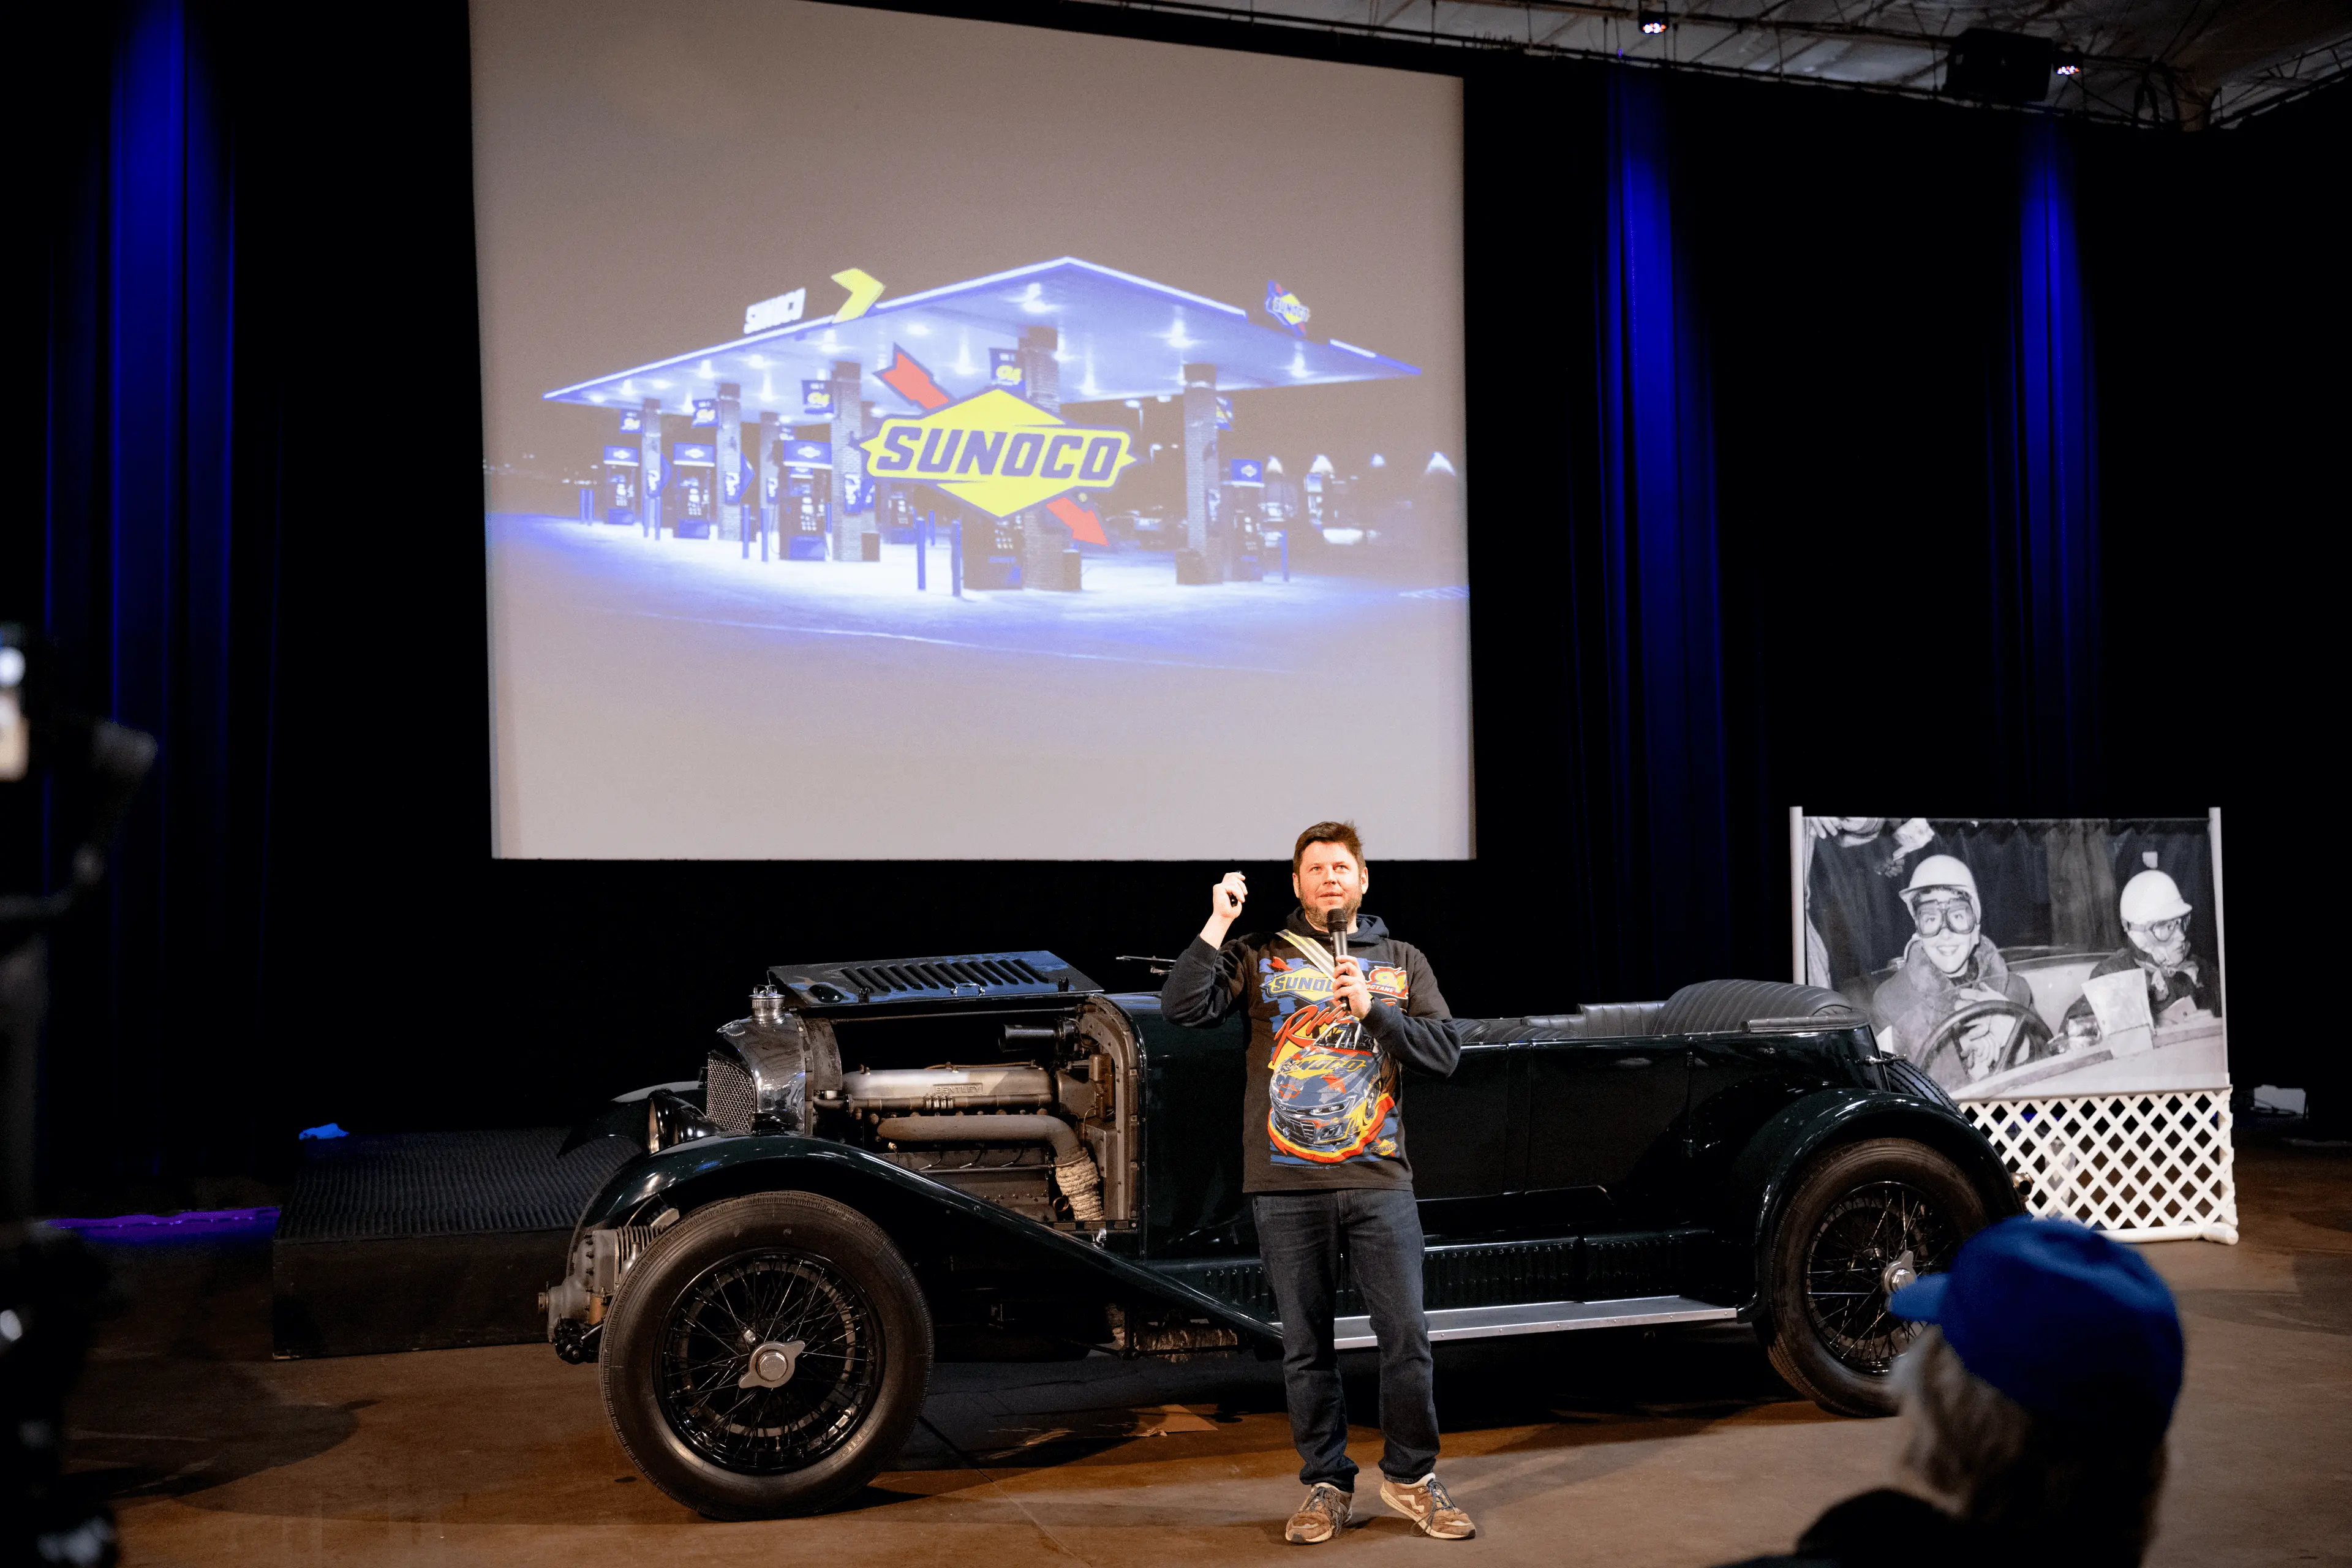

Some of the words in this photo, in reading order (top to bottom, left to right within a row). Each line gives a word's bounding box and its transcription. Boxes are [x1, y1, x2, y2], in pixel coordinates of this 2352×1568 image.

[876, 426, 1122, 481] SUNOCO
[1273, 976, 1333, 992] SUNO
[935, 1085, 981, 1094] BENTLEY
[835, 1423, 872, 1459] DUNLOP
